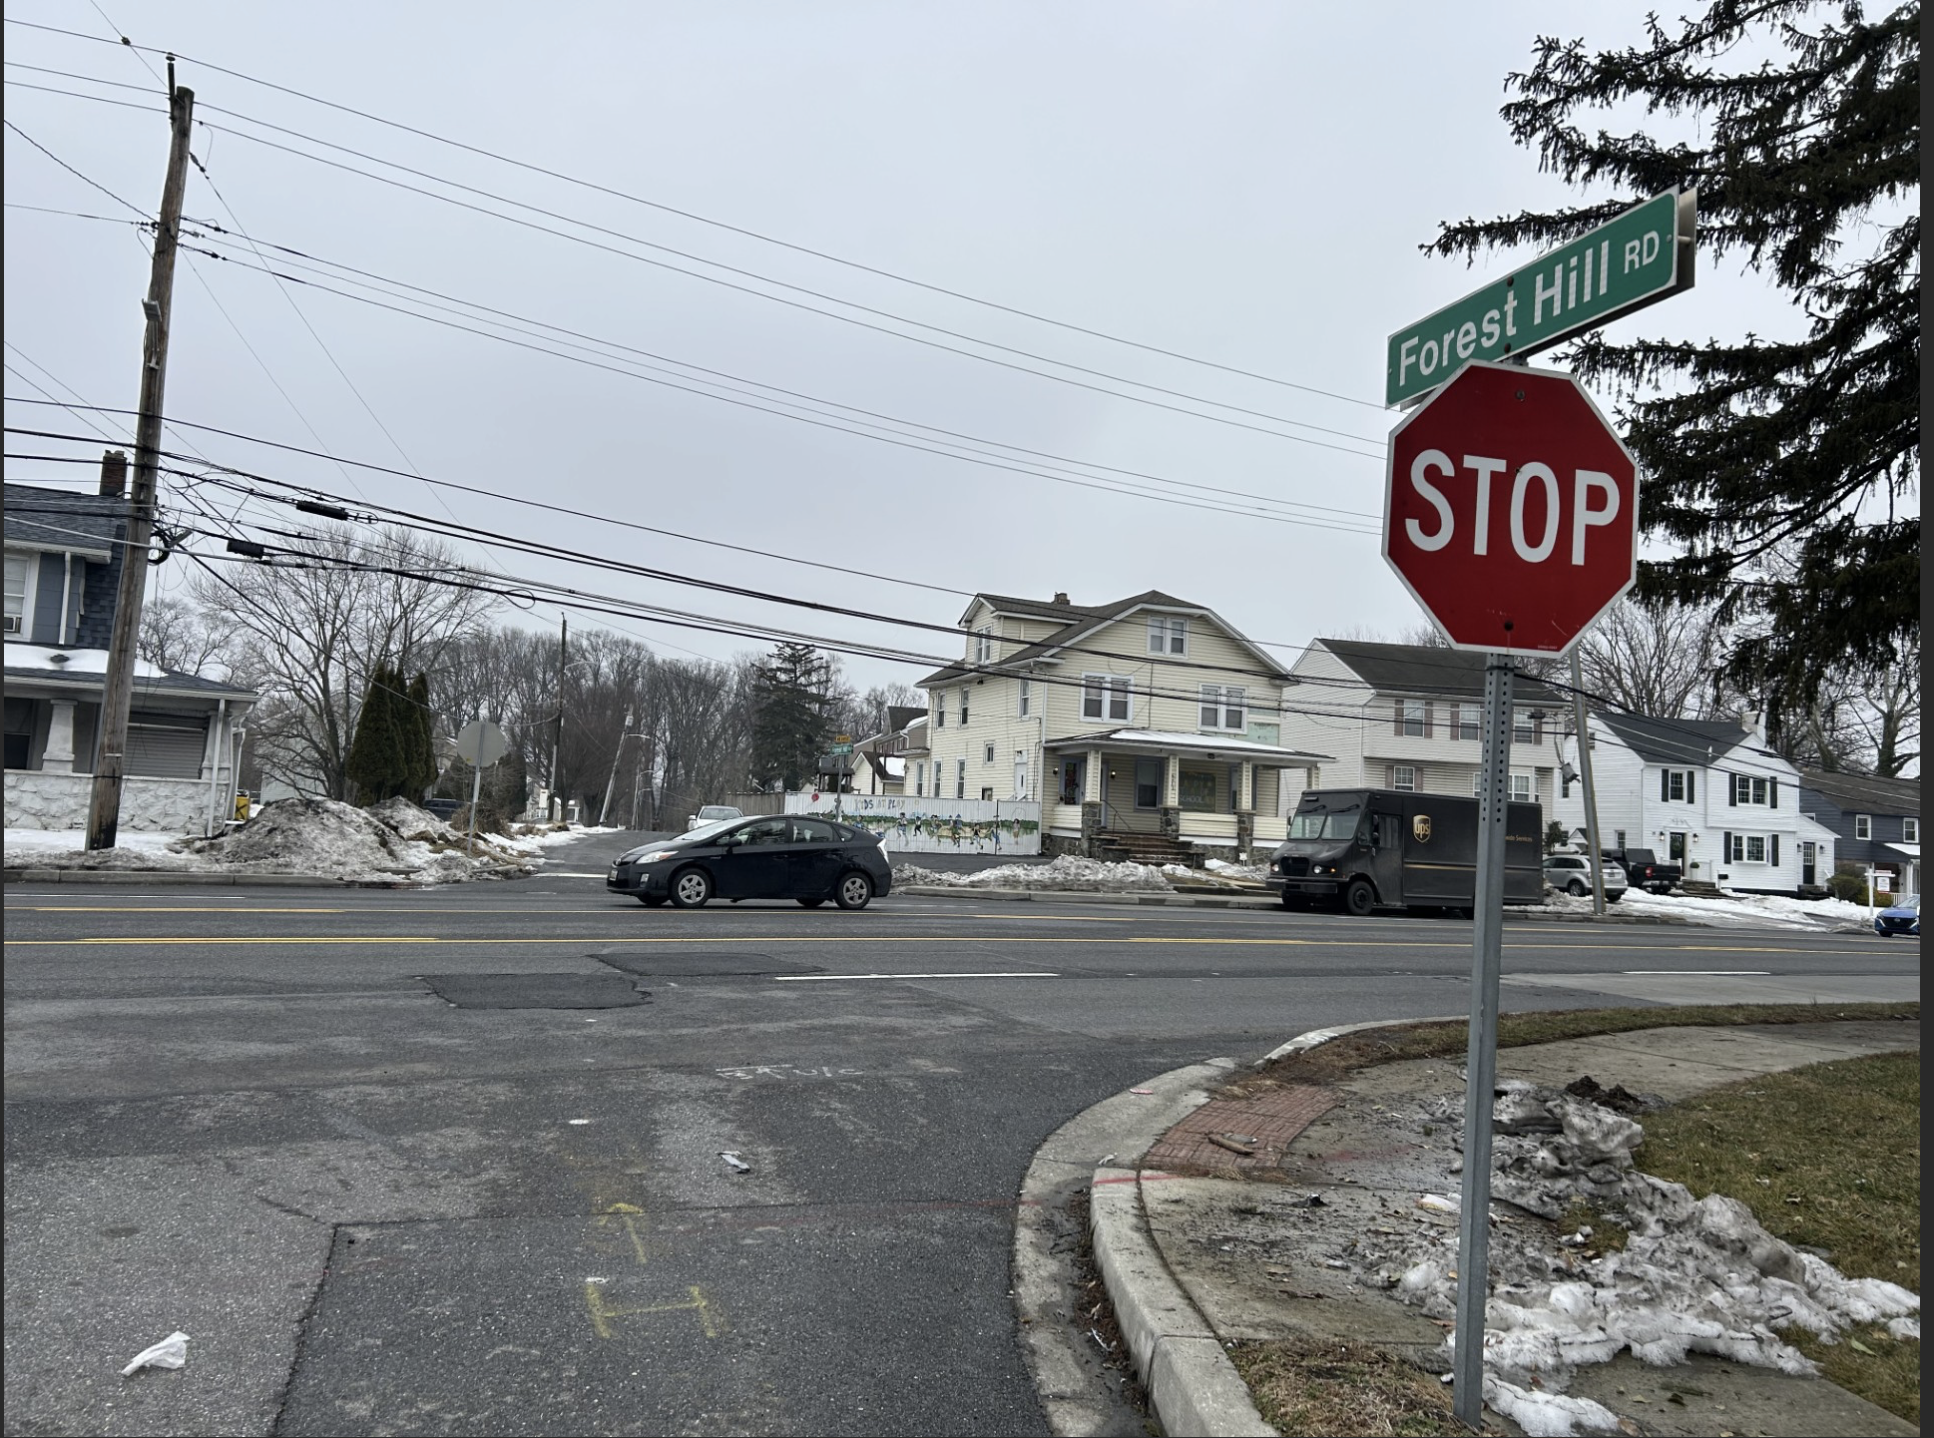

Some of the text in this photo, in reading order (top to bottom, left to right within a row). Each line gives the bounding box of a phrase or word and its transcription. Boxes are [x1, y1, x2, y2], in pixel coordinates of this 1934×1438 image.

[1399, 230, 1660, 386] Forest Hill RD
[1405, 448, 1620, 566] STOP
[854, 798, 905, 811] KIDS AT PLAY
[1415, 823, 1429, 838] ups
